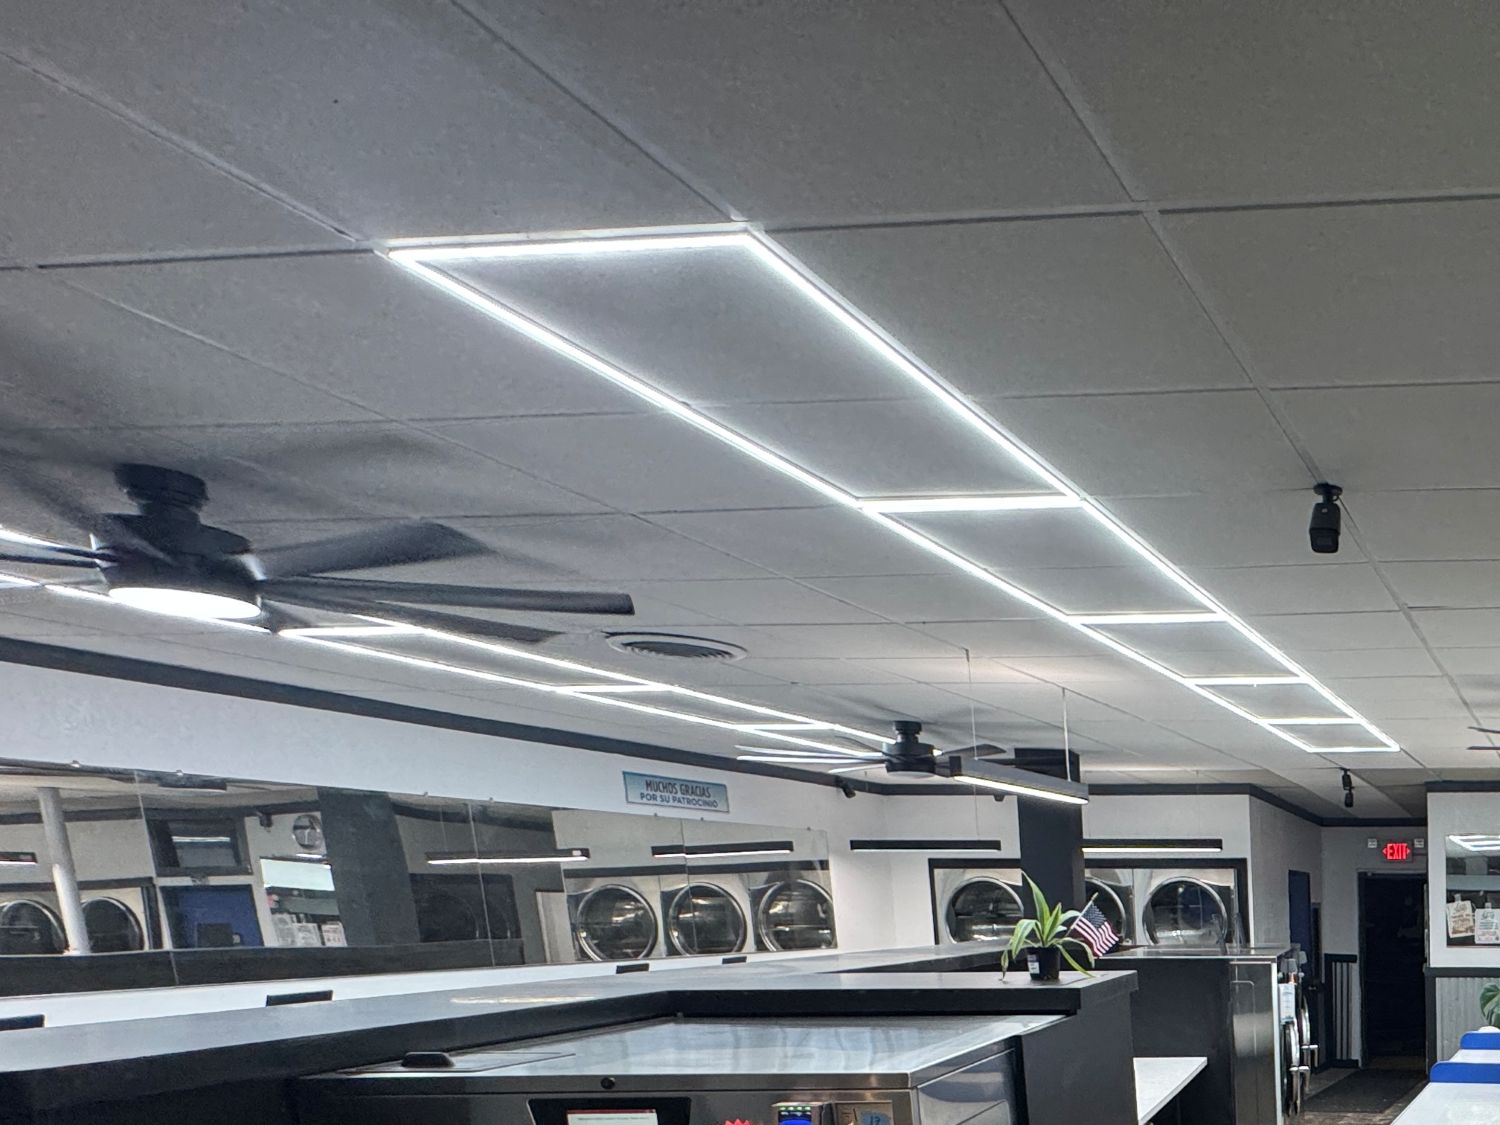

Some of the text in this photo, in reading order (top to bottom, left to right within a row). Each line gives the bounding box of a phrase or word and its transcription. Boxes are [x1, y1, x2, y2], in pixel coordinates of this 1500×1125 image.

[645, 779, 711, 798] MUCHOS GRACIAS
[640, 792, 719, 808] POR SU PATROCINIO
[1386, 843, 1407, 860] EXIT
